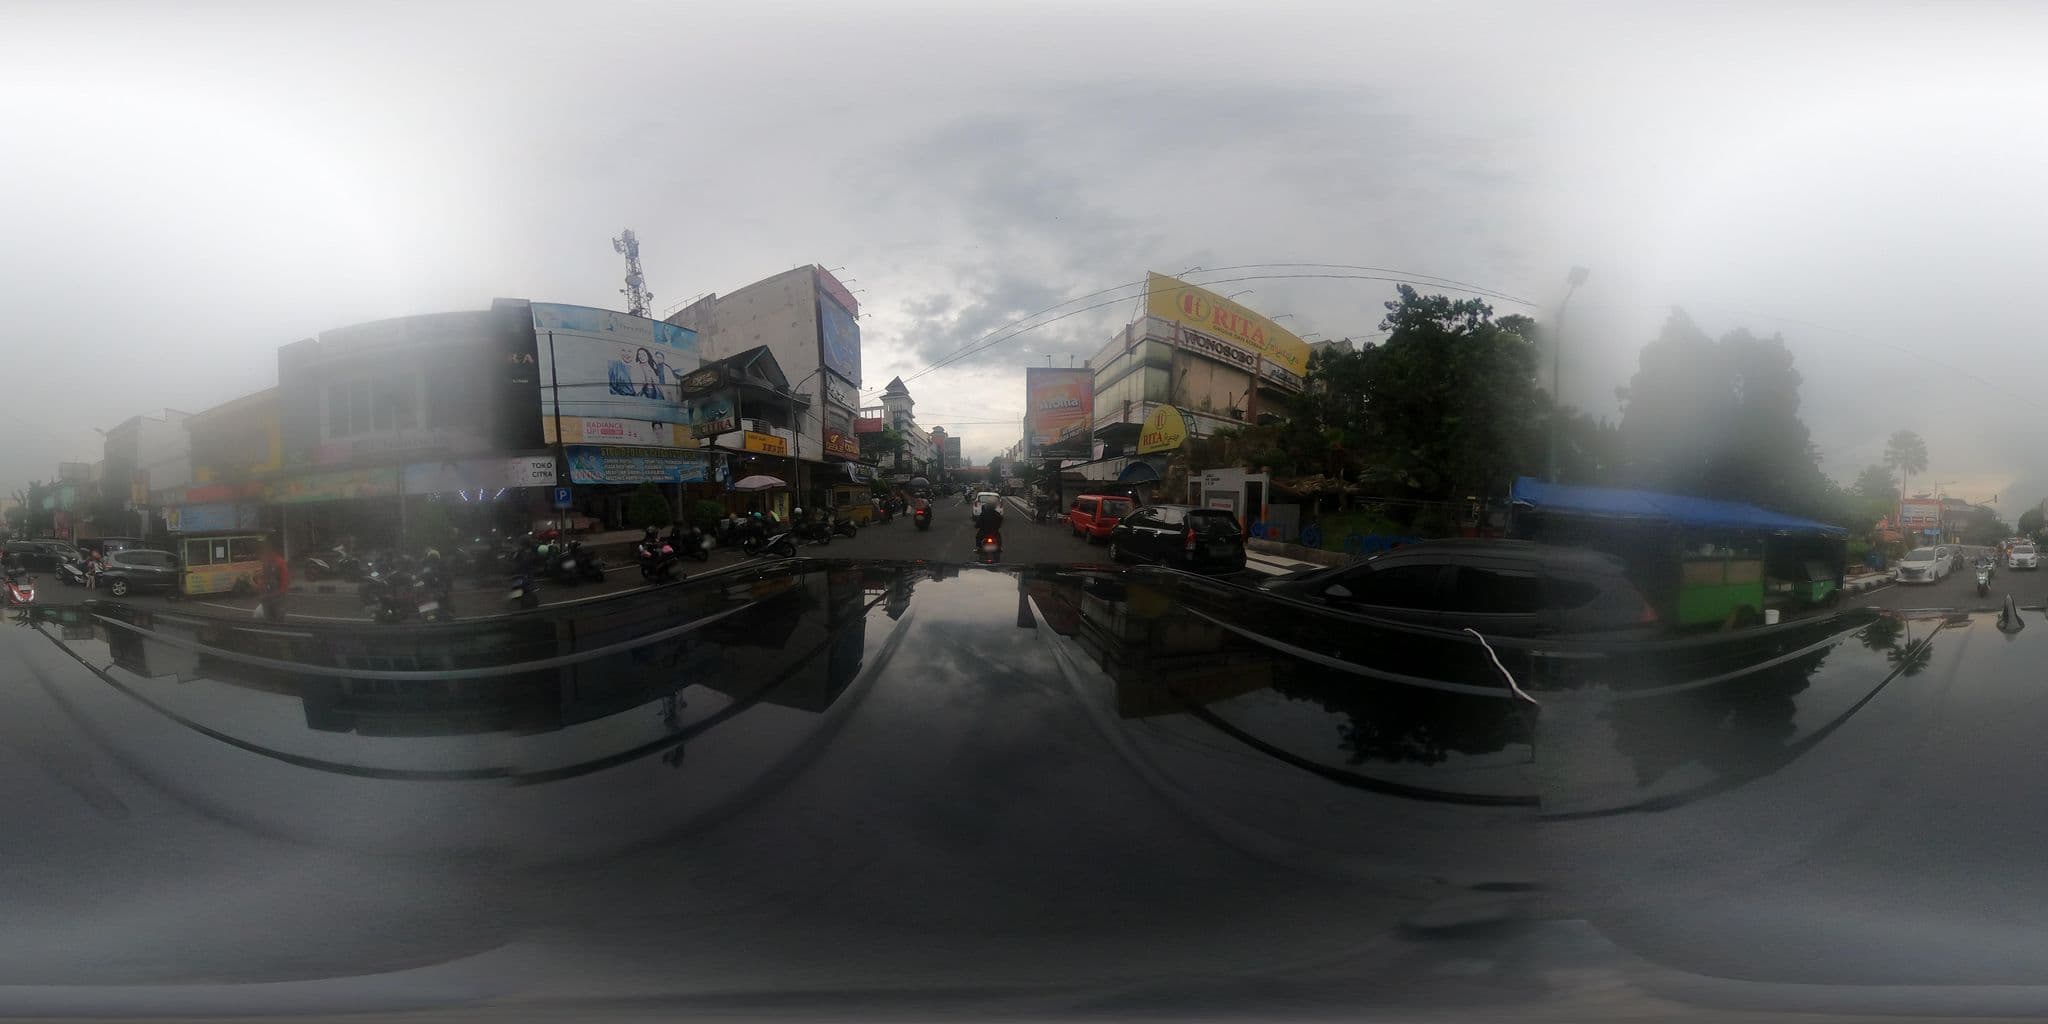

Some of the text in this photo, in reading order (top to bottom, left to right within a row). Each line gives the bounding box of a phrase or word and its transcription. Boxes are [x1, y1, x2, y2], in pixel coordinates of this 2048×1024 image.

[1212, 306, 1265, 346] RITA
[1183, 330, 1254, 366] WONOSOBO
[586, 421, 624, 429] RADIANCE
[1142, 431, 1163, 446] RITA
[531, 461, 552, 469] TOKO
[531, 470, 553, 479] CITRA
[559, 490, 567, 500] P
